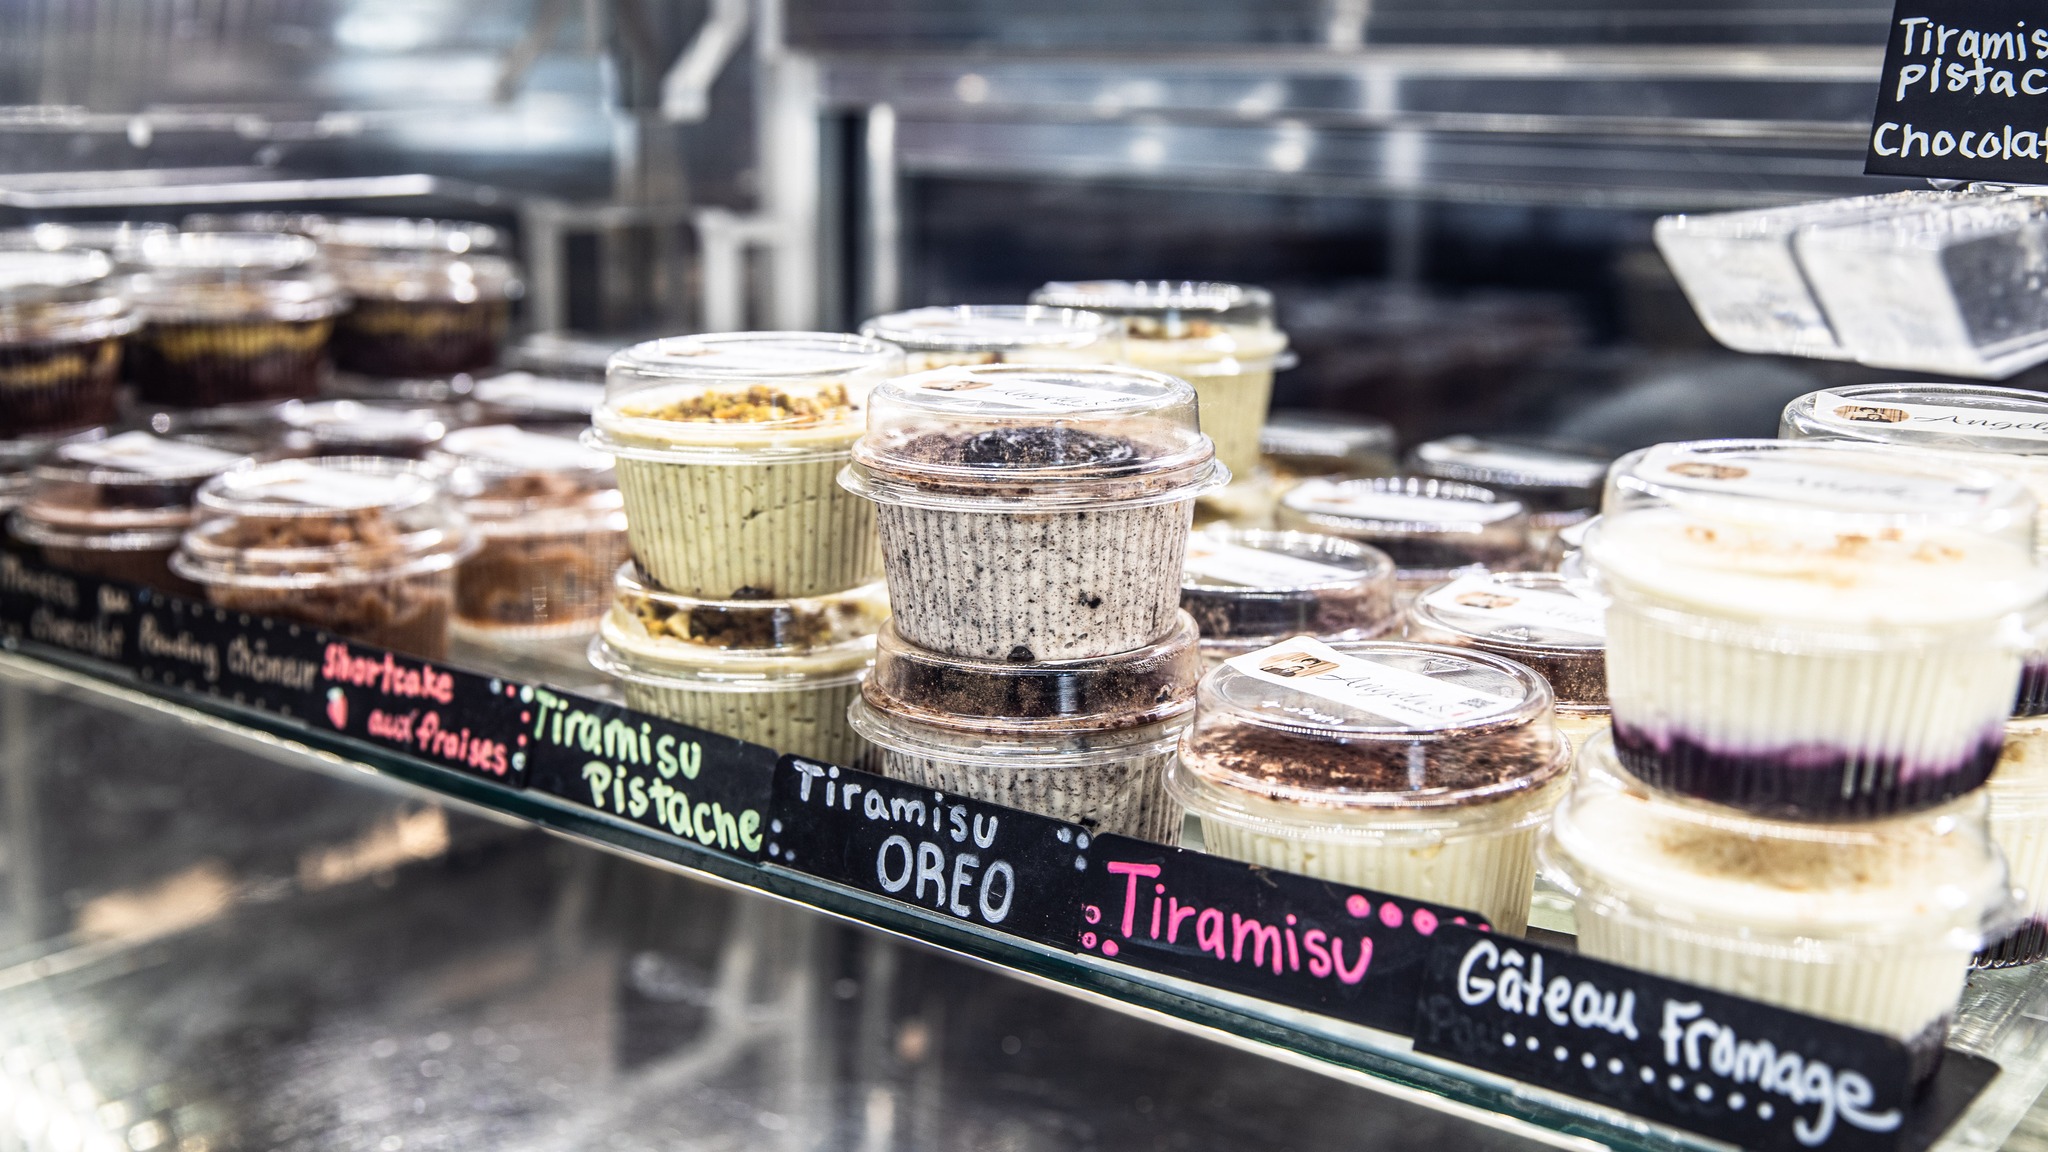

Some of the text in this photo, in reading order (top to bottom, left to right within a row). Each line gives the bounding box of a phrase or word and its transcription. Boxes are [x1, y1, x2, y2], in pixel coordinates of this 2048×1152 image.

[322, 642, 454, 704] Shortcake
[535, 688, 702, 780] Tiramisu
[582, 760, 763, 853] Pistache
[793, 759, 999, 849] Tiramisu
[876, 834, 1015, 924] OREO
[1107, 860, 1374, 985] Tiramisu
[1457, 939, 1640, 1041] Gâteau
[1660, 1000, 1902, 1147] Fromage
